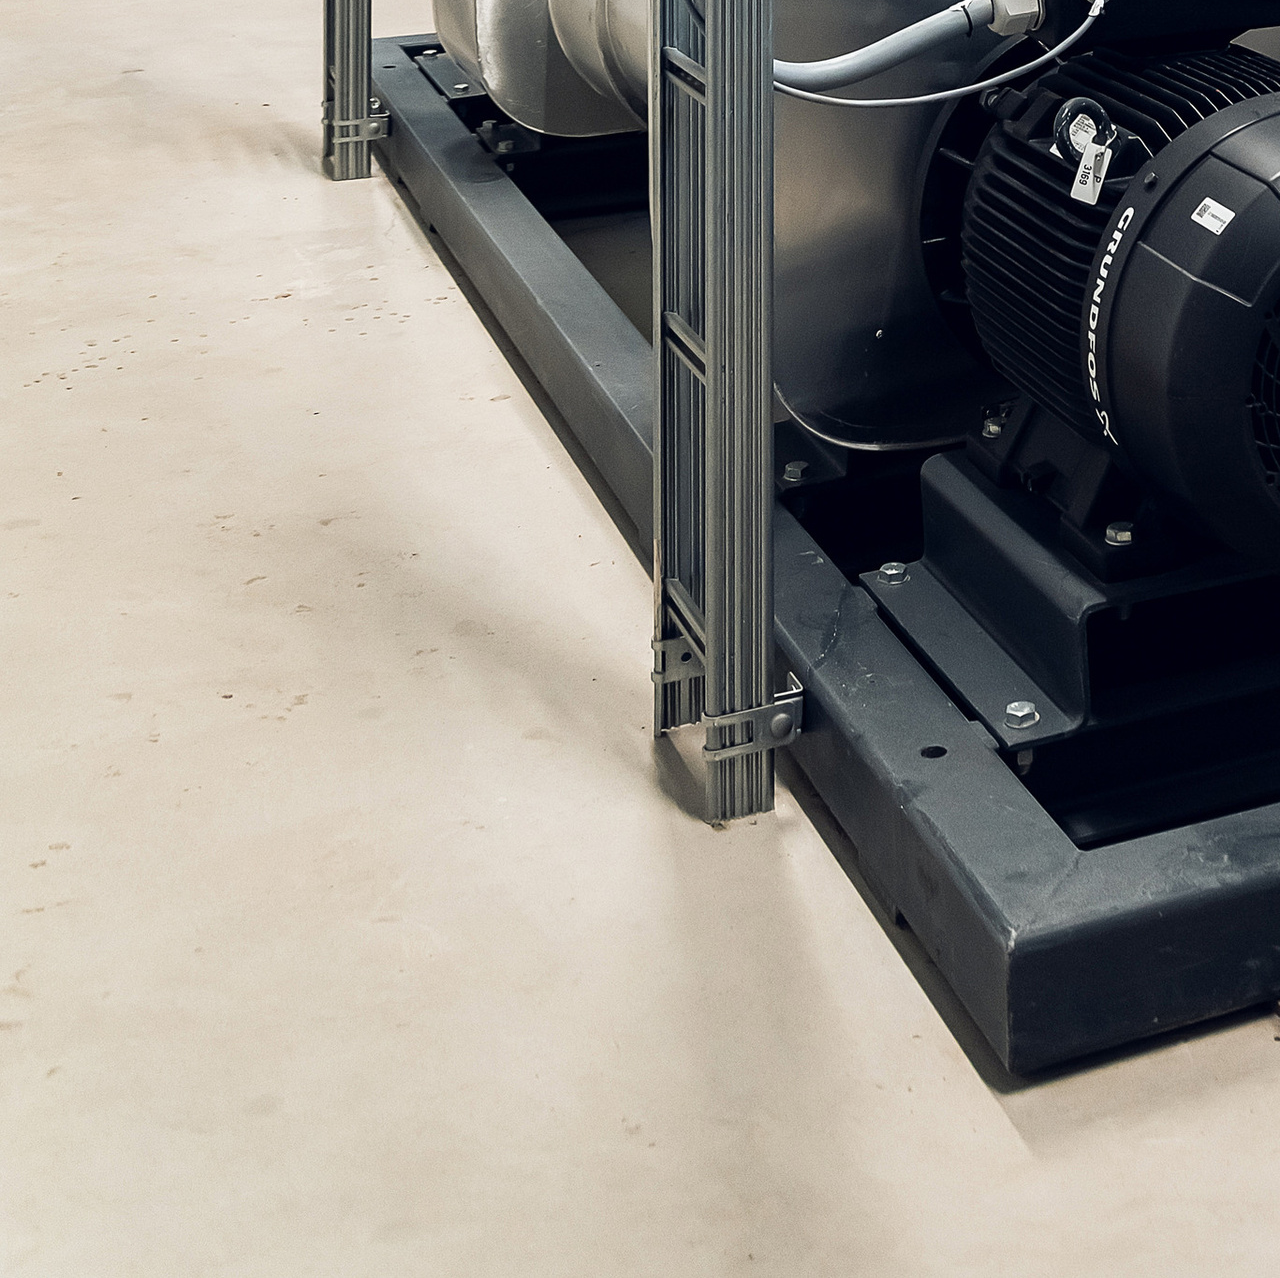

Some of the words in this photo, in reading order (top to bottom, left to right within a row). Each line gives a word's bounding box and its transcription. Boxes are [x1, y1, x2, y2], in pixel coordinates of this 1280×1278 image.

[1078, 164, 1092, 186] 3169
[1094, 175, 1102, 184] P
[1087, 206, 1135, 403] GRUNDFOS
